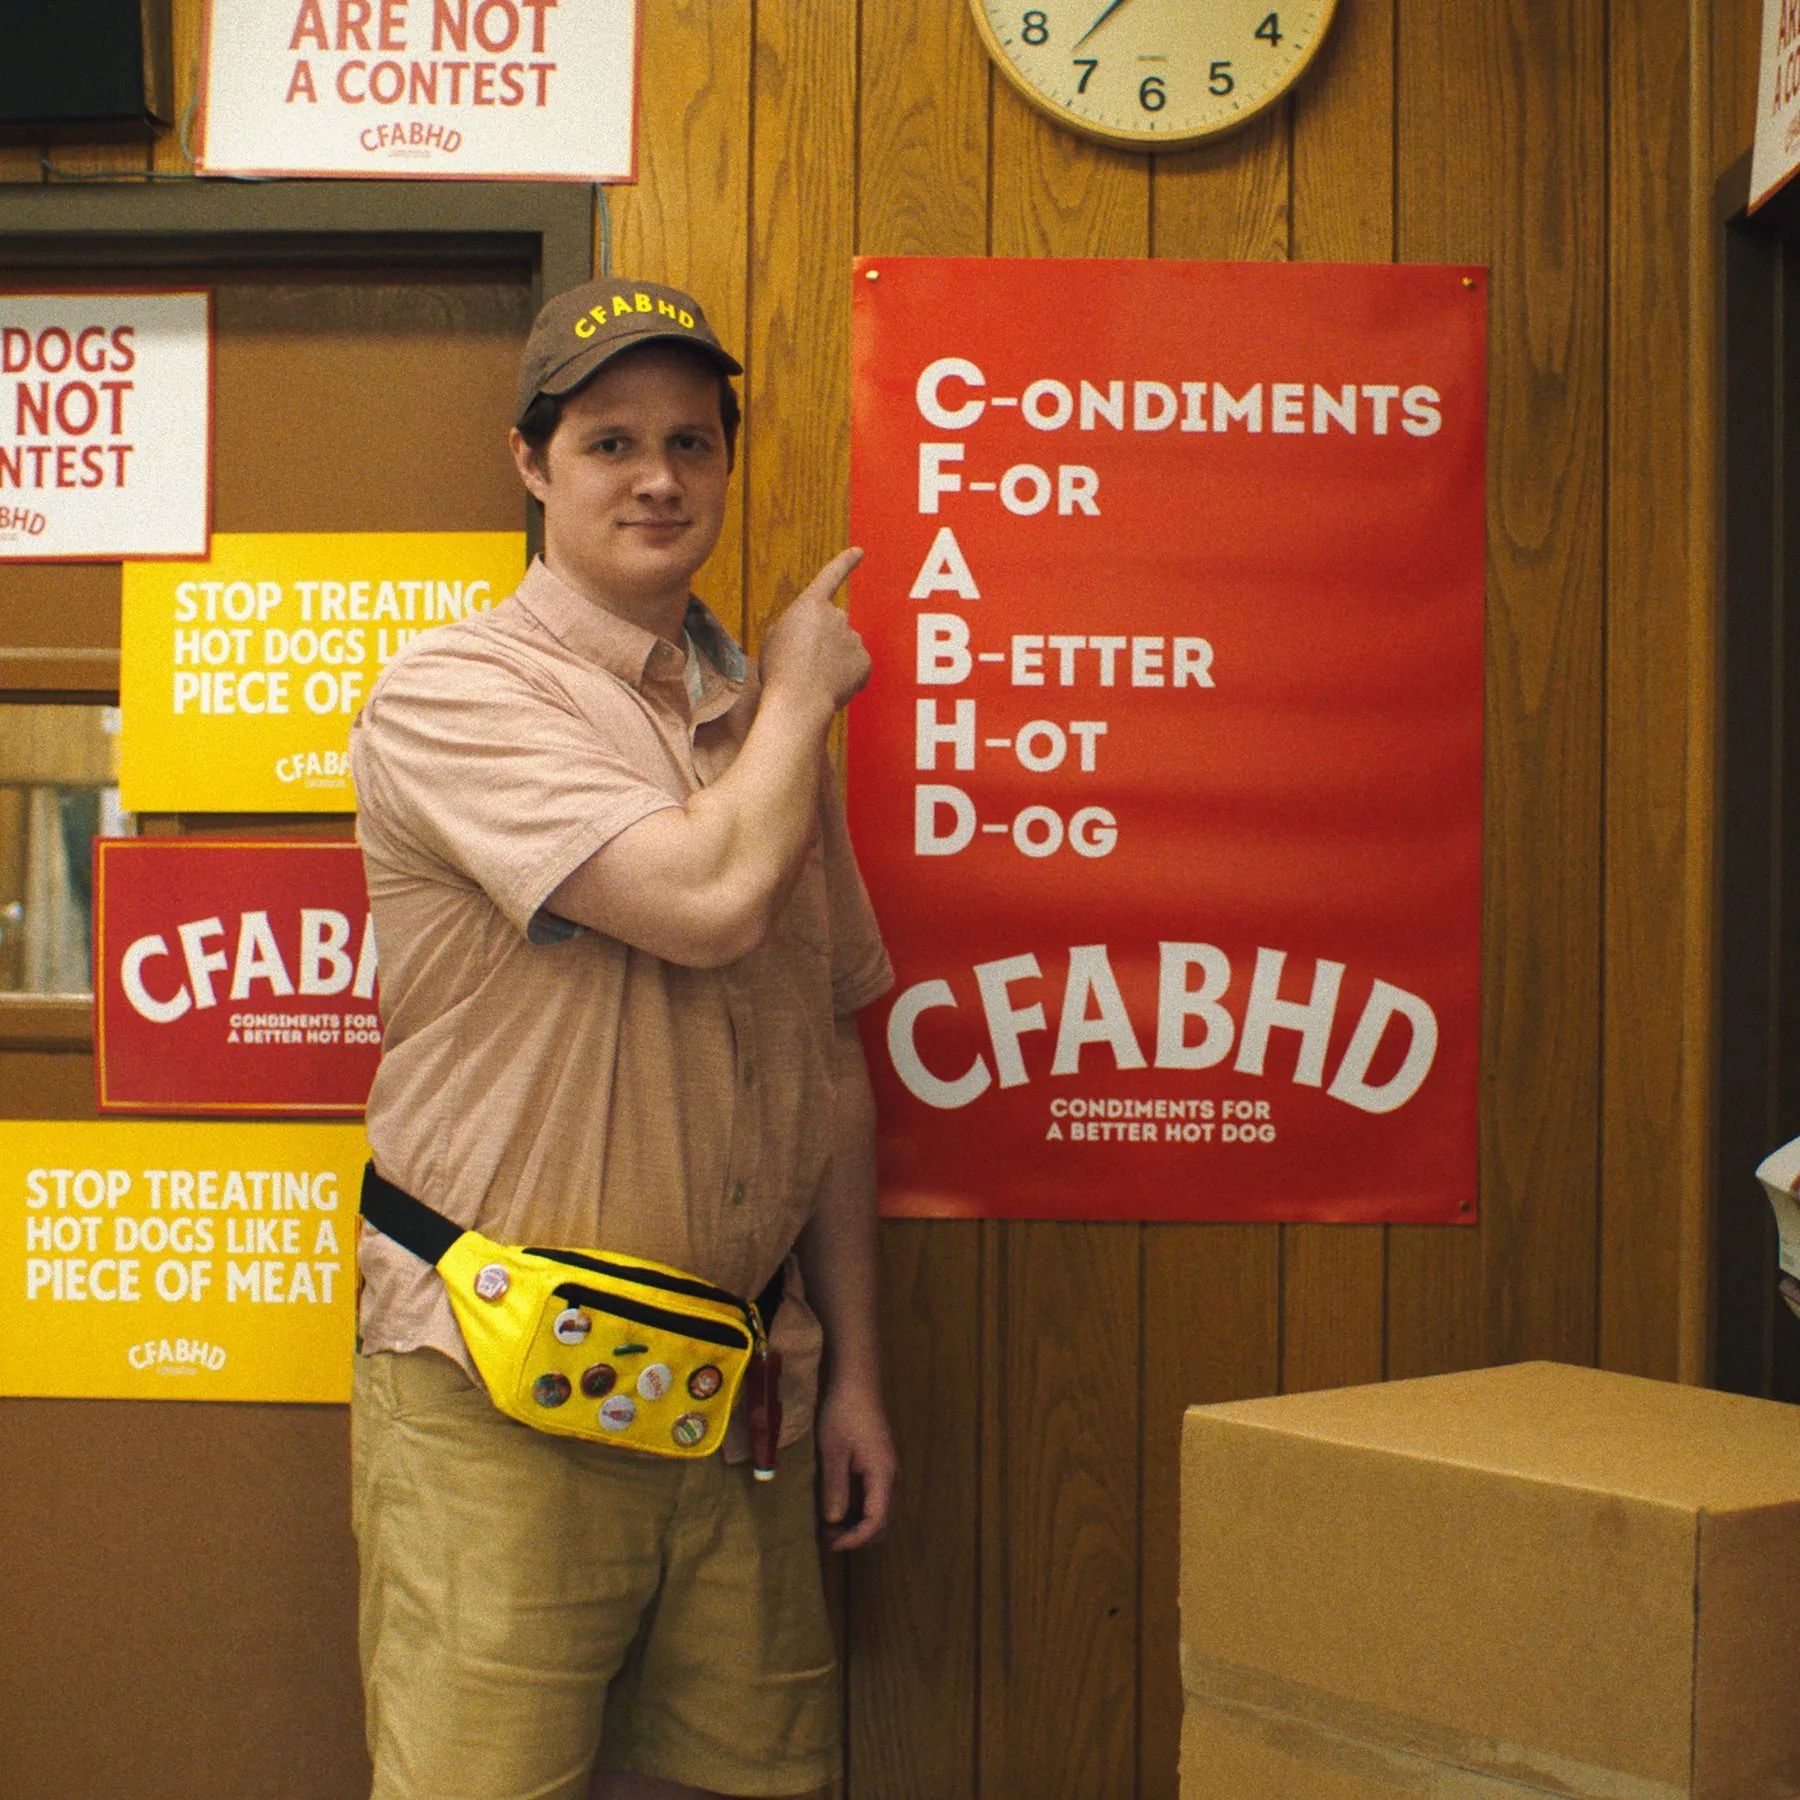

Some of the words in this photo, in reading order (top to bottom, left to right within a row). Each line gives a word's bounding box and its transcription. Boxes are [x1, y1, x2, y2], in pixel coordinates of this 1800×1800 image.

[288, 0, 408, 51] ARE
[432, 0, 558, 54] NOT
[1021, 11, 1048, 45] 8
[1254, 12, 1282, 47] 4
[285, 60, 318, 103] A
[335, 60, 557, 107] CONTEST
[1072, 60, 1098, 94] 7
[1139, 77, 1166, 111] 6
[1208, 61, 1234, 95] 5
[360, 121, 462, 153] CFABHD
[575, 293, 695, 338] CFABHD
[3, 326, 135, 373] DOGS
[16, 380, 134, 436] NOT
[916, 357, 1442, 437] C-ONDIMENTS
[918, 443, 1101, 516] F-OR
[909, 527, 981, 600] A
[175, 581, 282, 622] STOP
[294, 581, 491, 620] TREATING
[174, 628, 253, 665] HOT
[265, 628, 366, 665] DOGS
[916, 613, 1216, 688] B-ETTER
[173, 671, 290, 715] PIECE
[304, 671, 364, 715] OF
[915, 698, 1108, 773] H-OT
[914, 784, 1118, 858] D-OG
[227, 1029, 241, 1044] A
[244, 1029, 303, 1044] BETTER
[306, 1029, 342, 1044] HOT
[344, 1029, 382, 1045] DOG
[229, 1013, 340, 1028] CONDIMENTS
[344, 1013, 378, 1028] FOR
[887, 941, 1438, 1114] CFABHD
[1050, 1098, 1215, 1119] CONDIMENTS
[1222, 1100, 1271, 1120] FOR
[1046, 1121, 1063, 1141] A
[1070, 1121, 1158, 1142] BETTER
[1165, 1122, 1216, 1143] HOT
[1221, 1123, 1276, 1143] DOG
[26, 1168, 132, 1210] STOP
[143, 1170, 338, 1211] TREATING
[26, 1216, 102, 1252] HOT
[114, 1216, 215, 1254] DOGS
[226, 1218, 302, 1255] LIKE
[314, 1219, 340, 1255] A
[26, 1258, 140, 1301] PIECE
[155, 1259, 212, 1302] OF
[226, 1260, 341, 1304] MEAT
[128, 1338, 227, 1371] CFABHD
